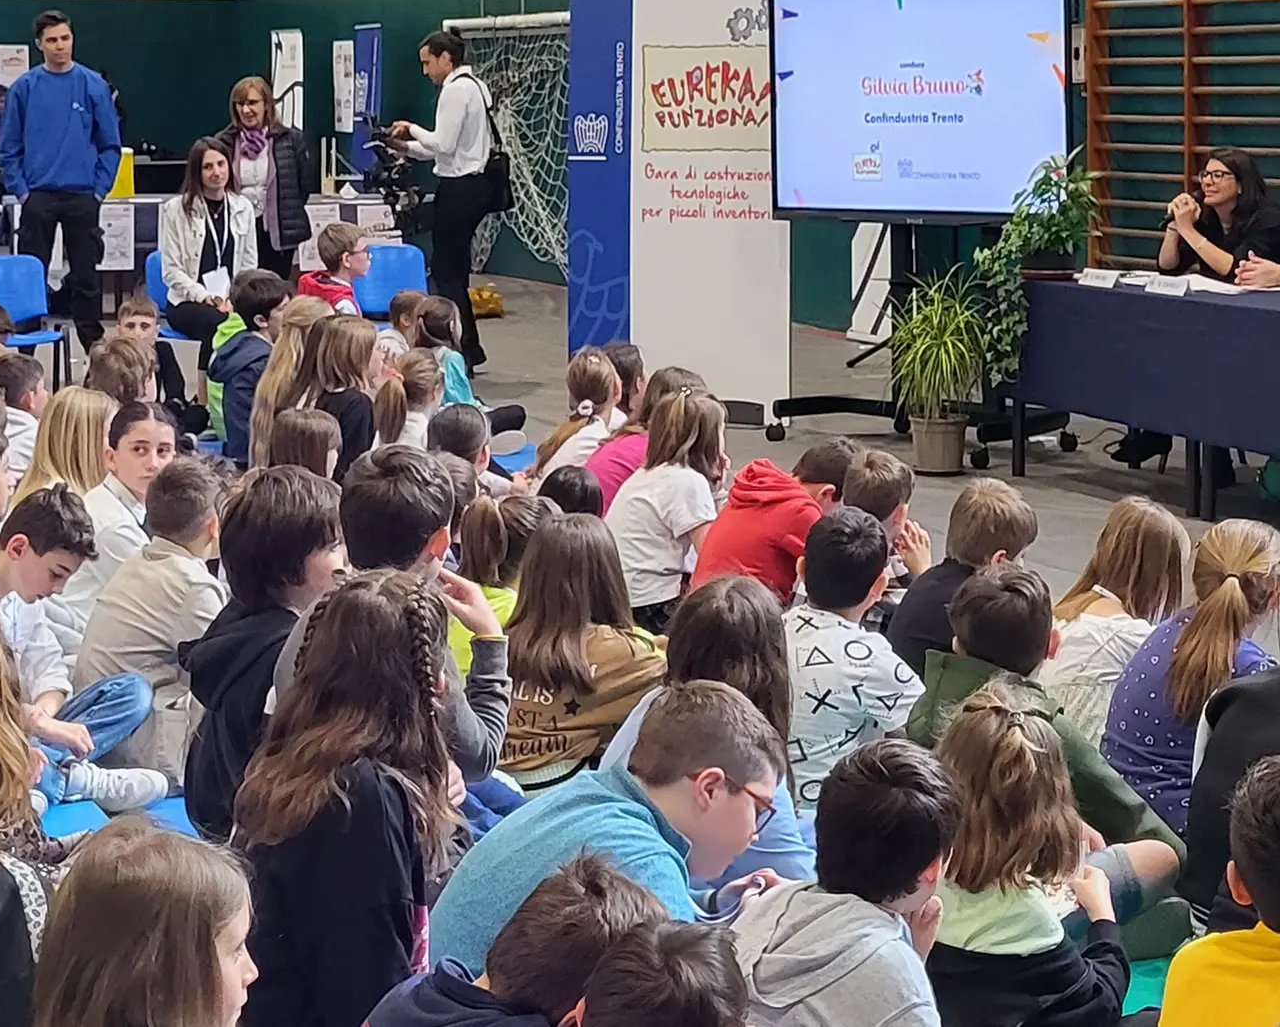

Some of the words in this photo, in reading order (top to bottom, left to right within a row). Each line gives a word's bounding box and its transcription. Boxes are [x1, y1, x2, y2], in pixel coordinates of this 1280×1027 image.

[616, 42, 624, 77] TRENTO
[862, 76, 909, 96] Silvia
[913, 75, 968, 95] Bruno
[615, 79, 624, 153] CONFINDUSTRIA
[864, 113, 929, 124] Confindustria
[931, 112, 964, 123] Trento
[645, 162, 679, 180] Gara
[685, 165, 697, 180] di
[704, 165, 773, 181] costruzion
[670, 184, 750, 205] tecnologiche
[641, 207, 663, 223] per
[669, 204, 706, 223] piccoli
